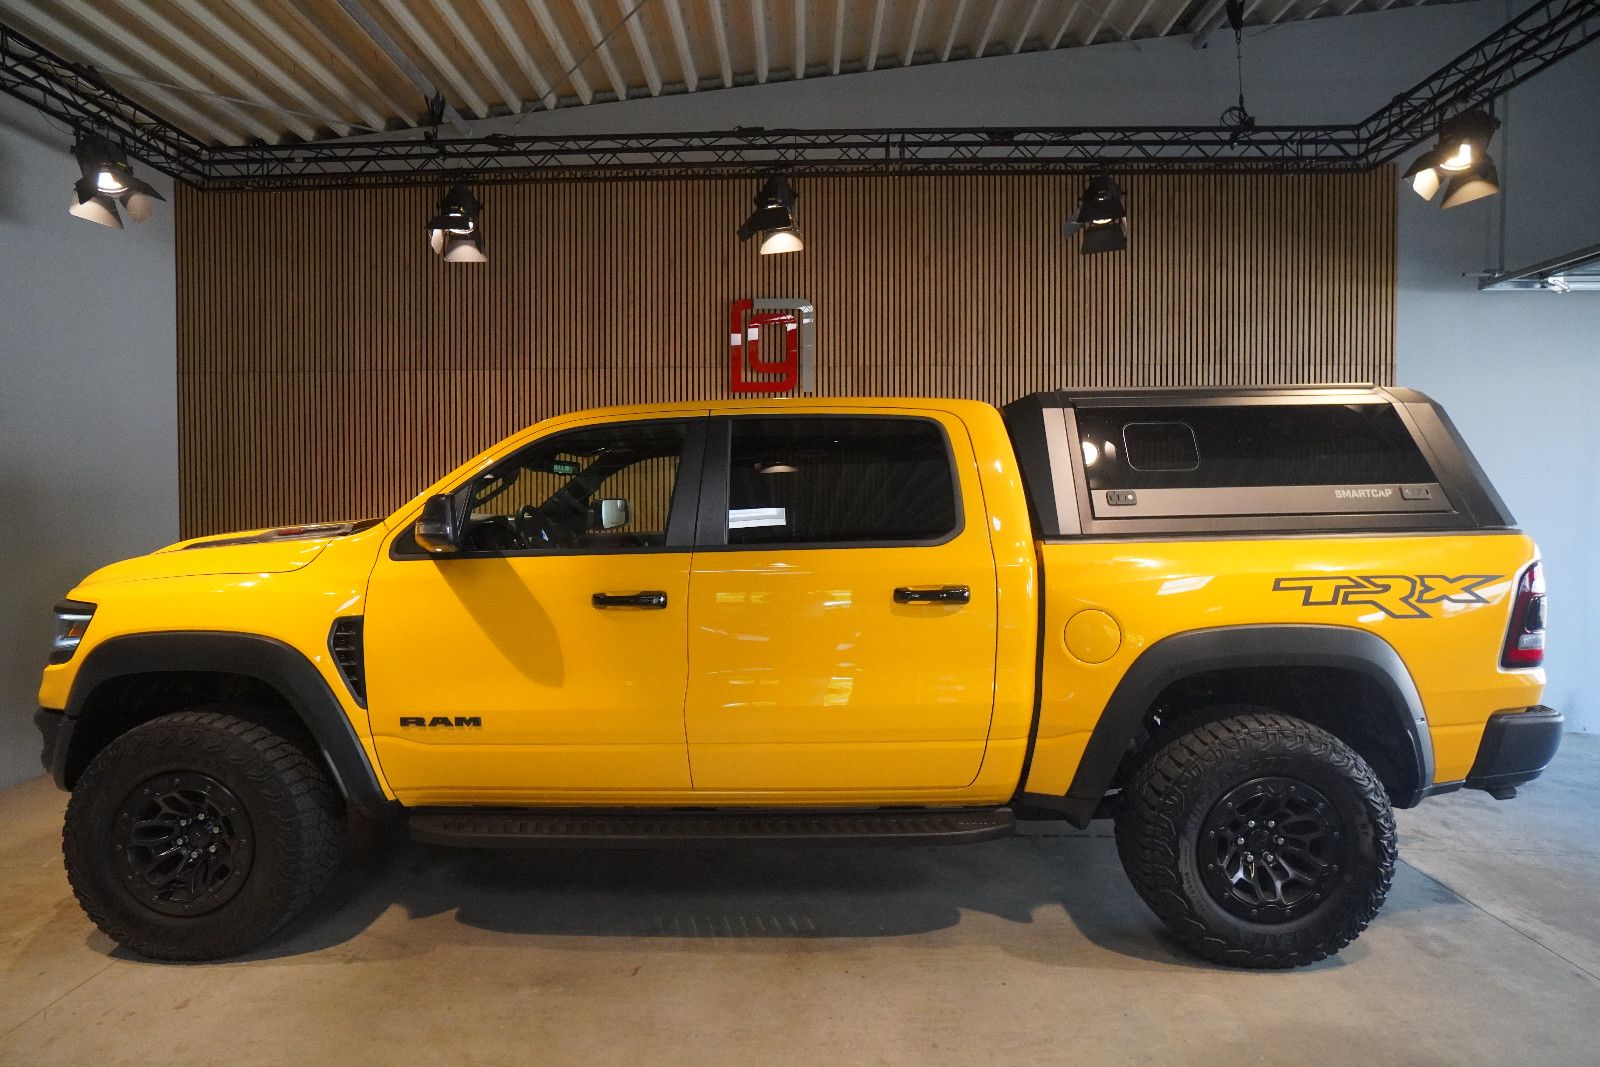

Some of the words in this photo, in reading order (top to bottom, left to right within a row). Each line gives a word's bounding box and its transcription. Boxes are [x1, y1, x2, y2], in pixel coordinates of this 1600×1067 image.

[1334, 488, 1393, 499] SMARTCAP
[1272, 574, 1504, 619] TRX
[400, 716, 482, 727] RAM
